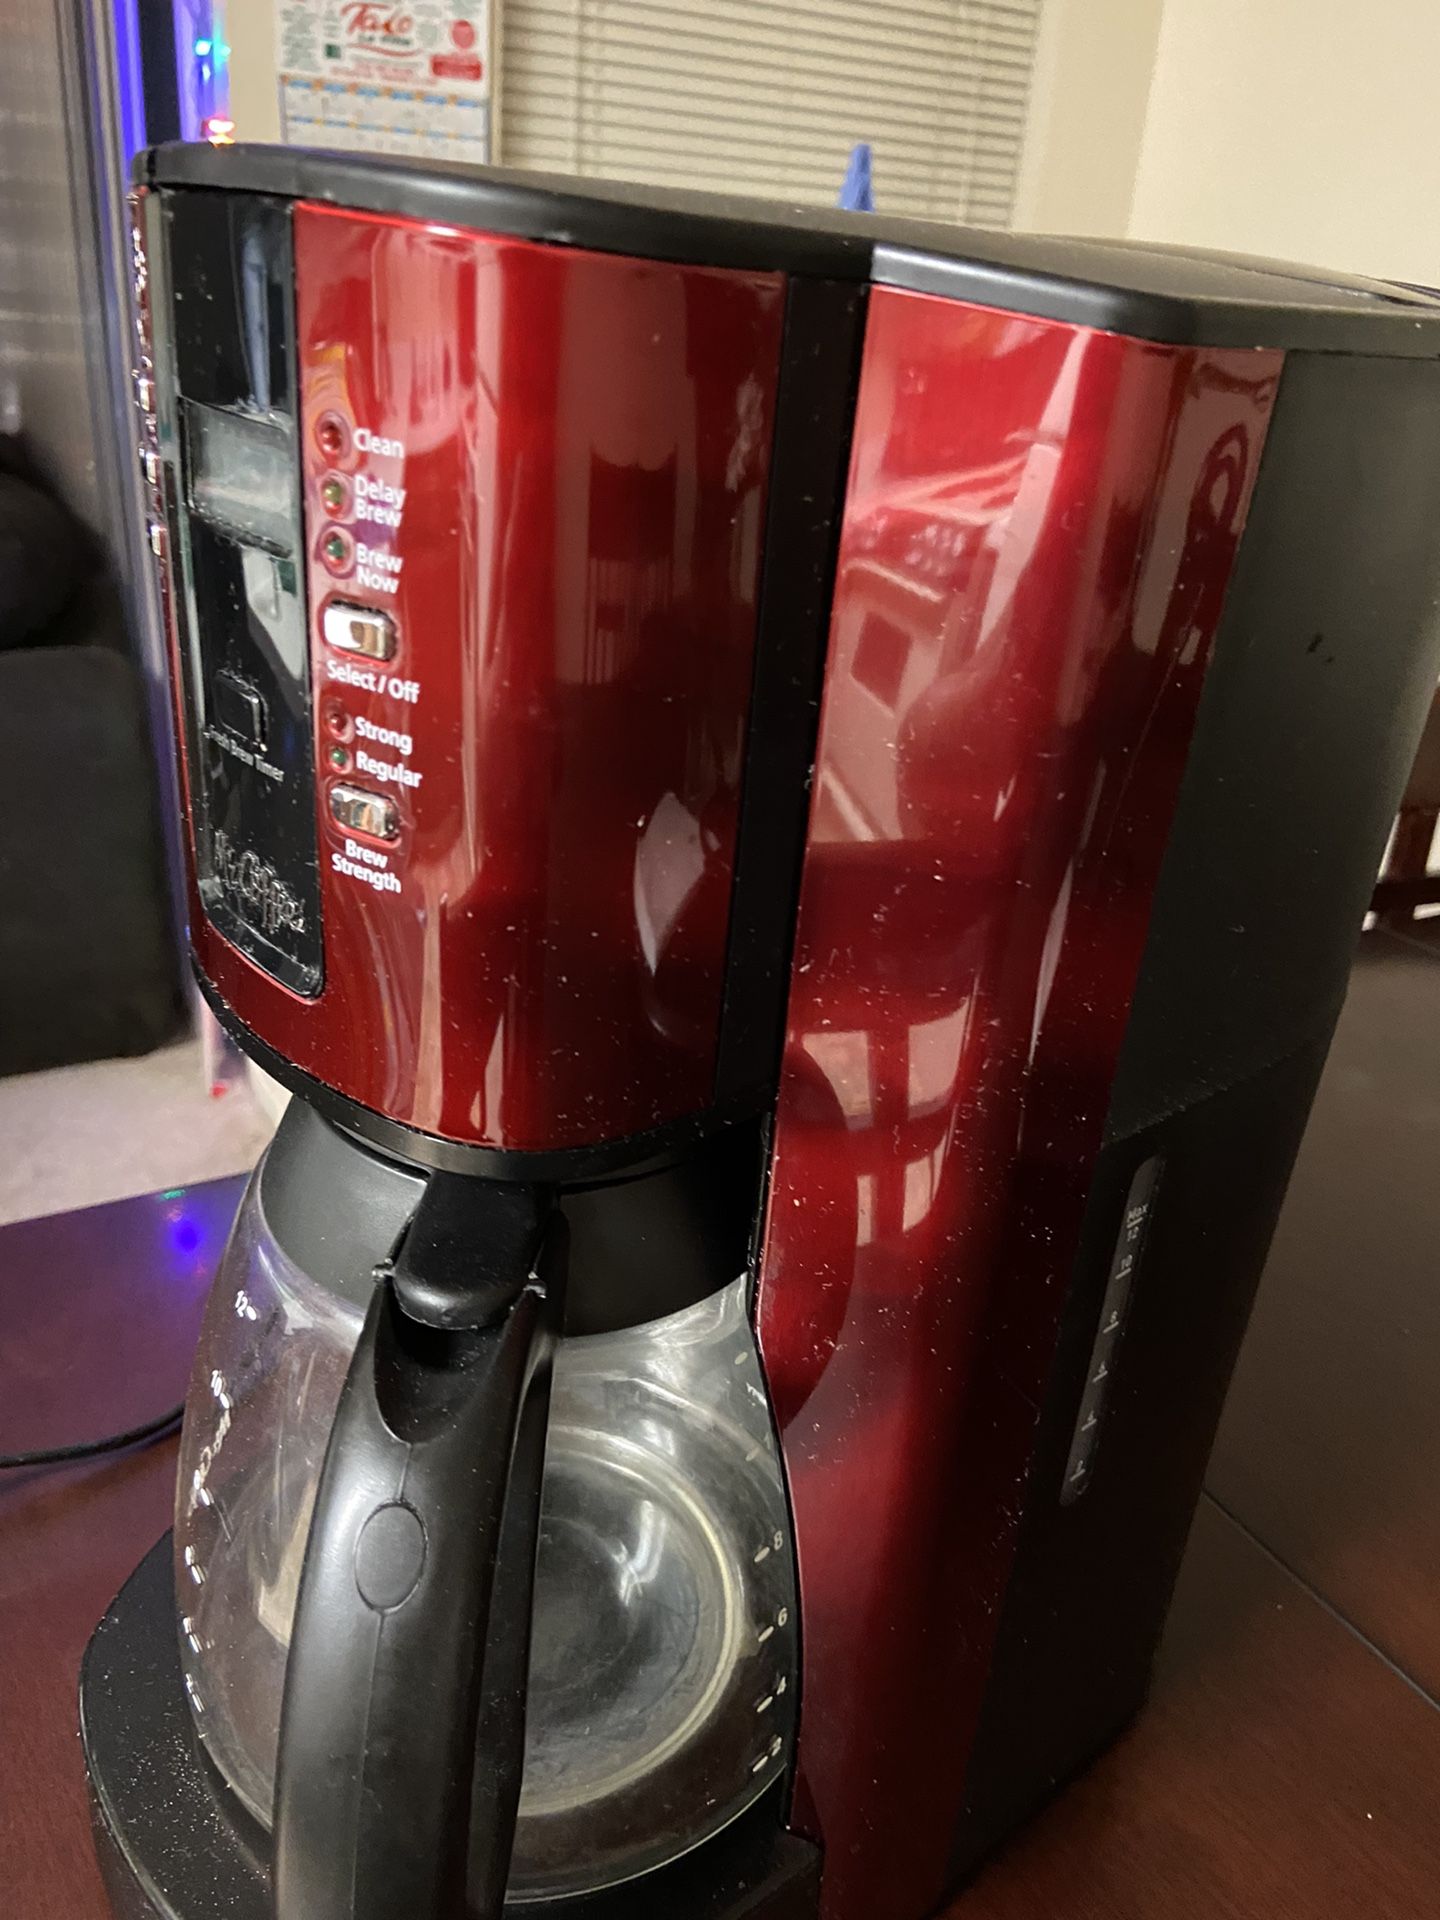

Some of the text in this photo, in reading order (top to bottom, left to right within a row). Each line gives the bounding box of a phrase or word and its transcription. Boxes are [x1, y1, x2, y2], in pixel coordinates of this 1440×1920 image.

[353, 428, 404, 459] Clean
[355, 475, 406, 510] Delay
[355, 498, 403, 527] Brew
[356, 543, 403, 573] Brew
[357, 565, 399, 594] Now
[327, 660, 376, 692] Select
[388, 678, 420, 704] Off
[355, 716, 413, 756] Strong
[356, 751, 422, 788] Regular
[345, 838, 388, 869] Brew
[332, 853, 401, 893] Strength
[235, 1290, 248, 1317] 12
[211, 1370, 222, 1397] 10
[773, 1531, 783, 1550] 8
[778, 1607, 788, 1627] 6
